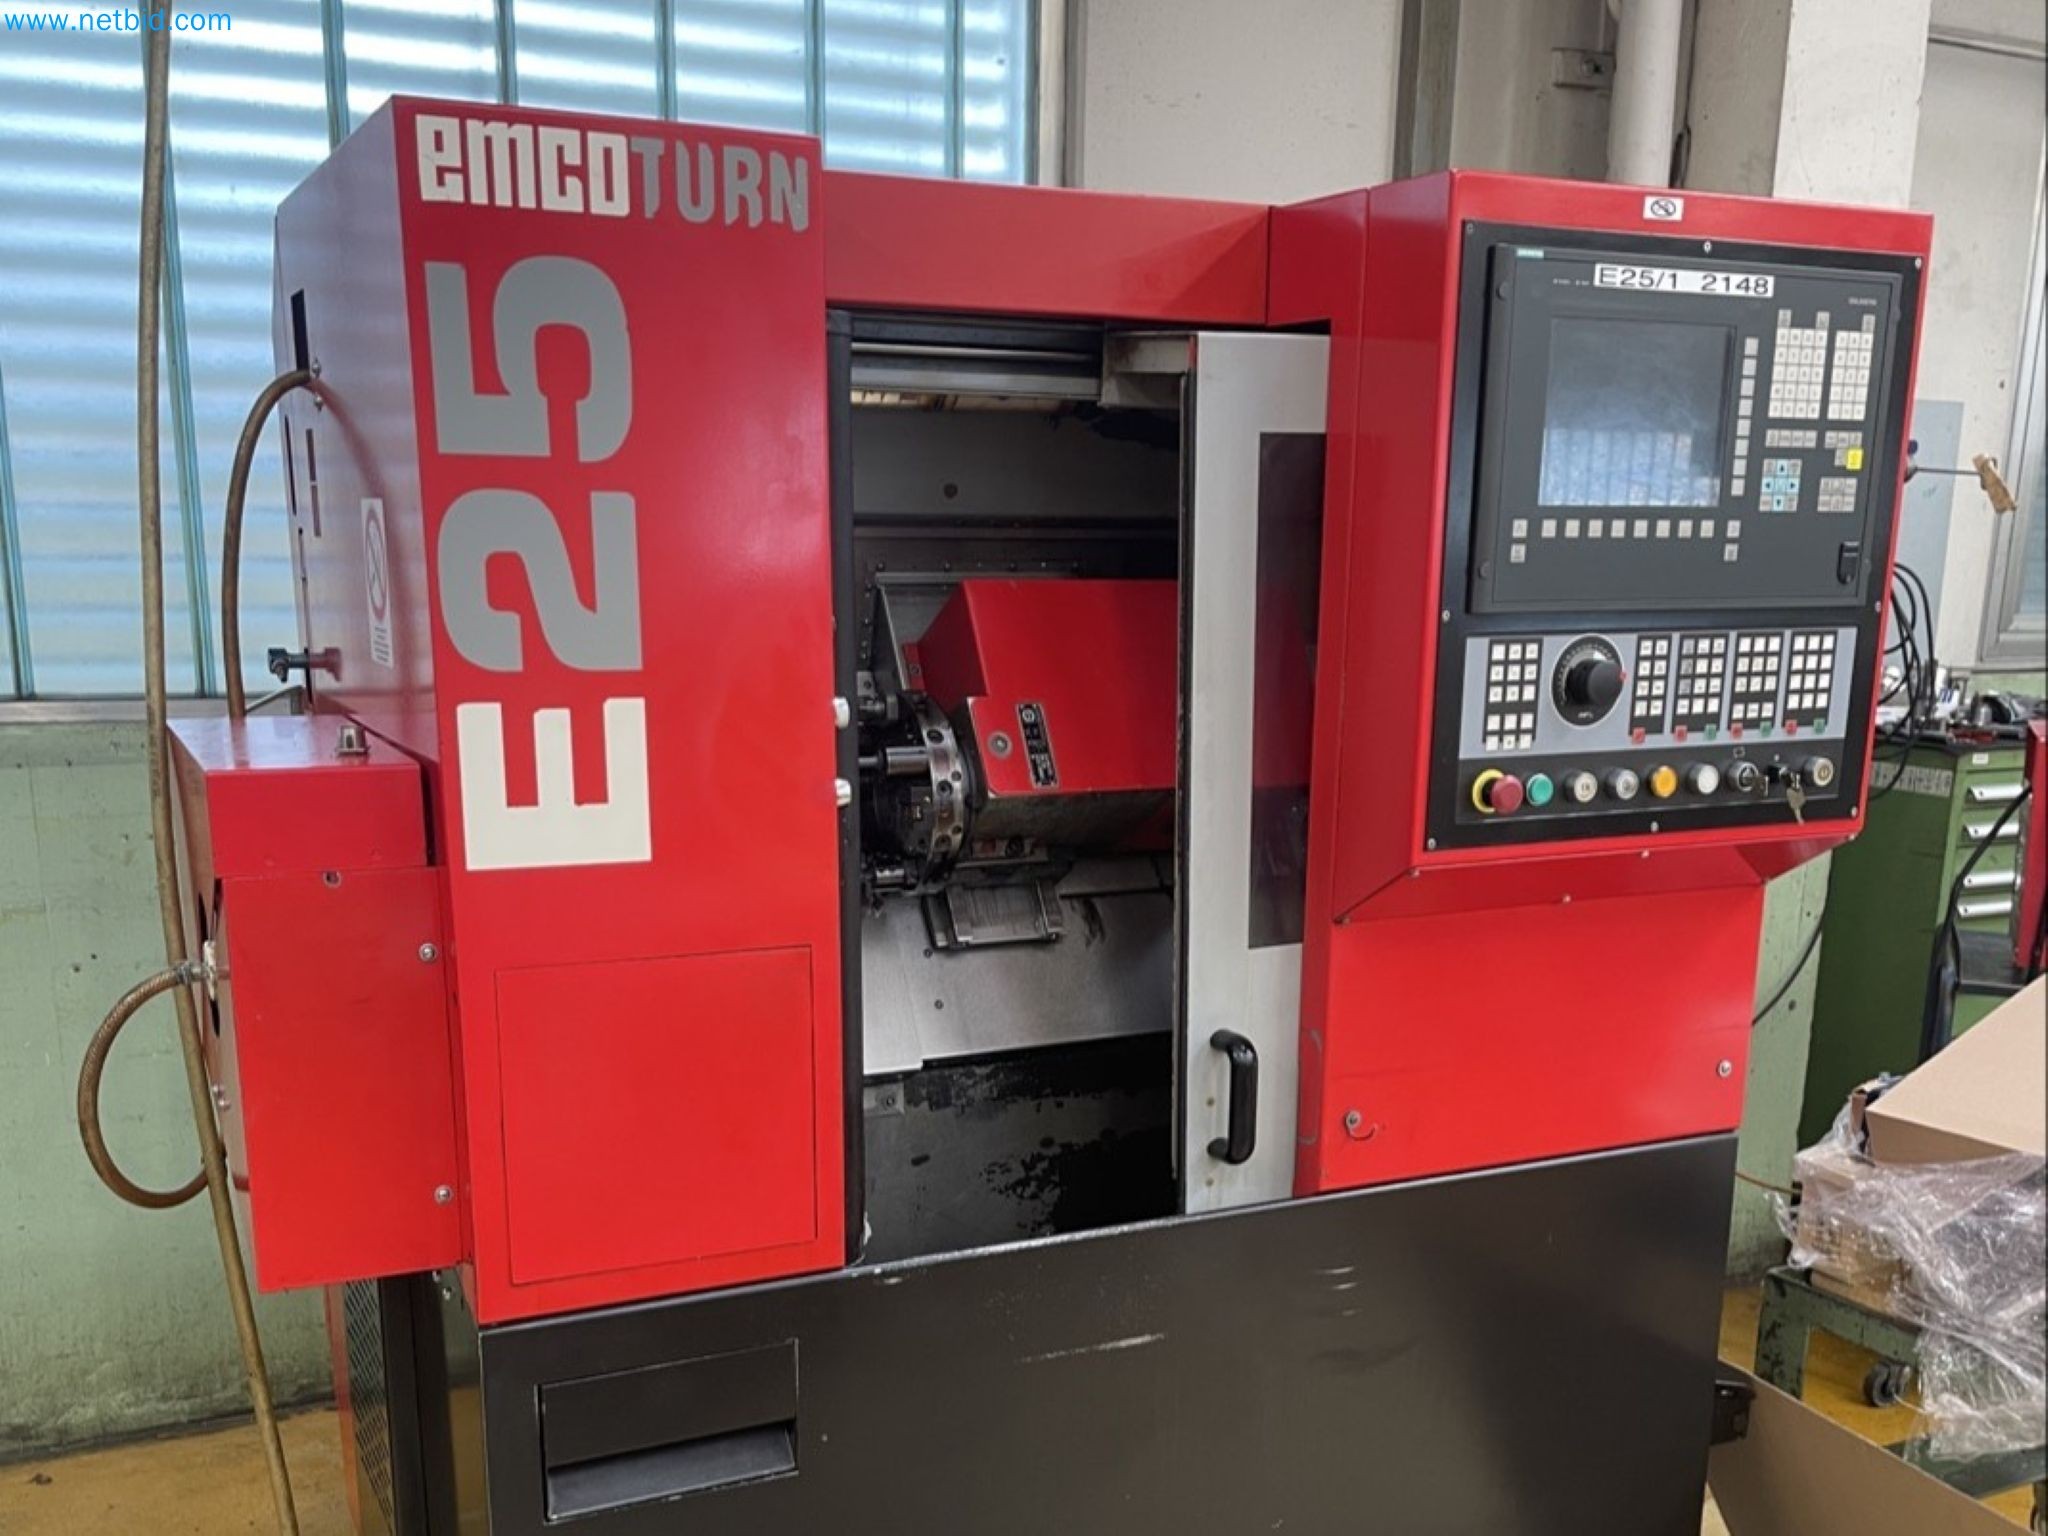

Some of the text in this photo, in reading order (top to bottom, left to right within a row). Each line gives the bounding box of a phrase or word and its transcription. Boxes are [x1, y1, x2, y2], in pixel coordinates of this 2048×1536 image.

[1599, 266, 1769, 296] E25/1 2148
[424, 255, 652, 871] E25
